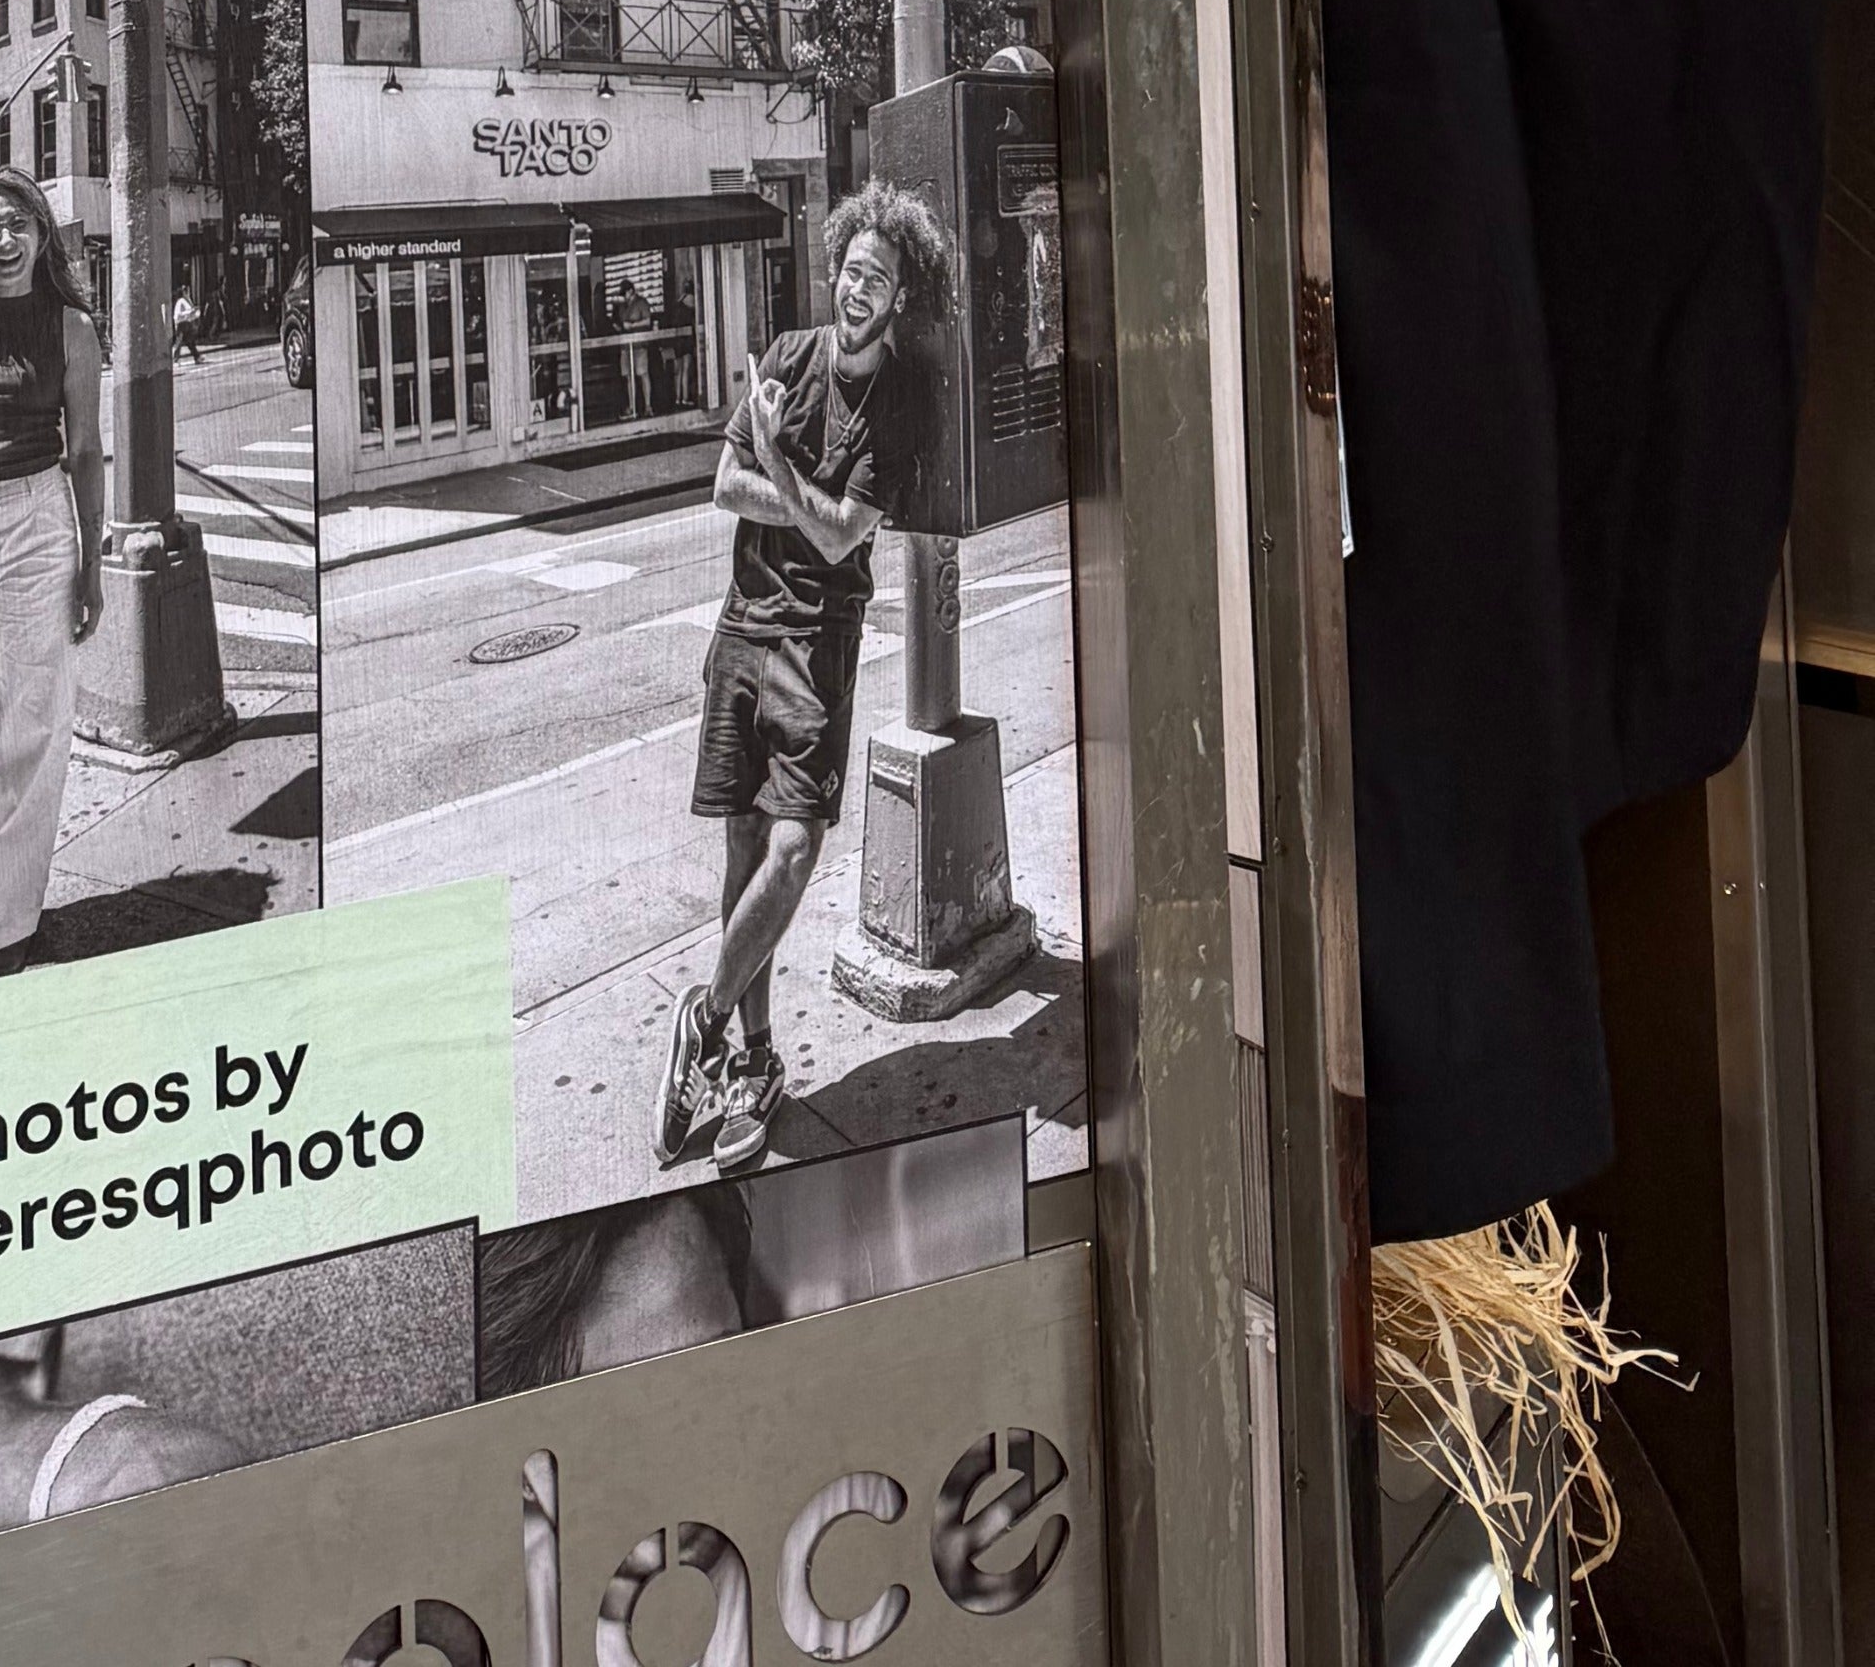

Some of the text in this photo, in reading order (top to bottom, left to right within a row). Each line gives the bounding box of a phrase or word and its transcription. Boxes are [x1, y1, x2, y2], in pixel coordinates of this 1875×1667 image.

[472, 118, 612, 154] SANTO
[490, 143, 598, 178] TACO
[333, 238, 462, 261] a higher standard
[214, 1042, 309, 1116] by
